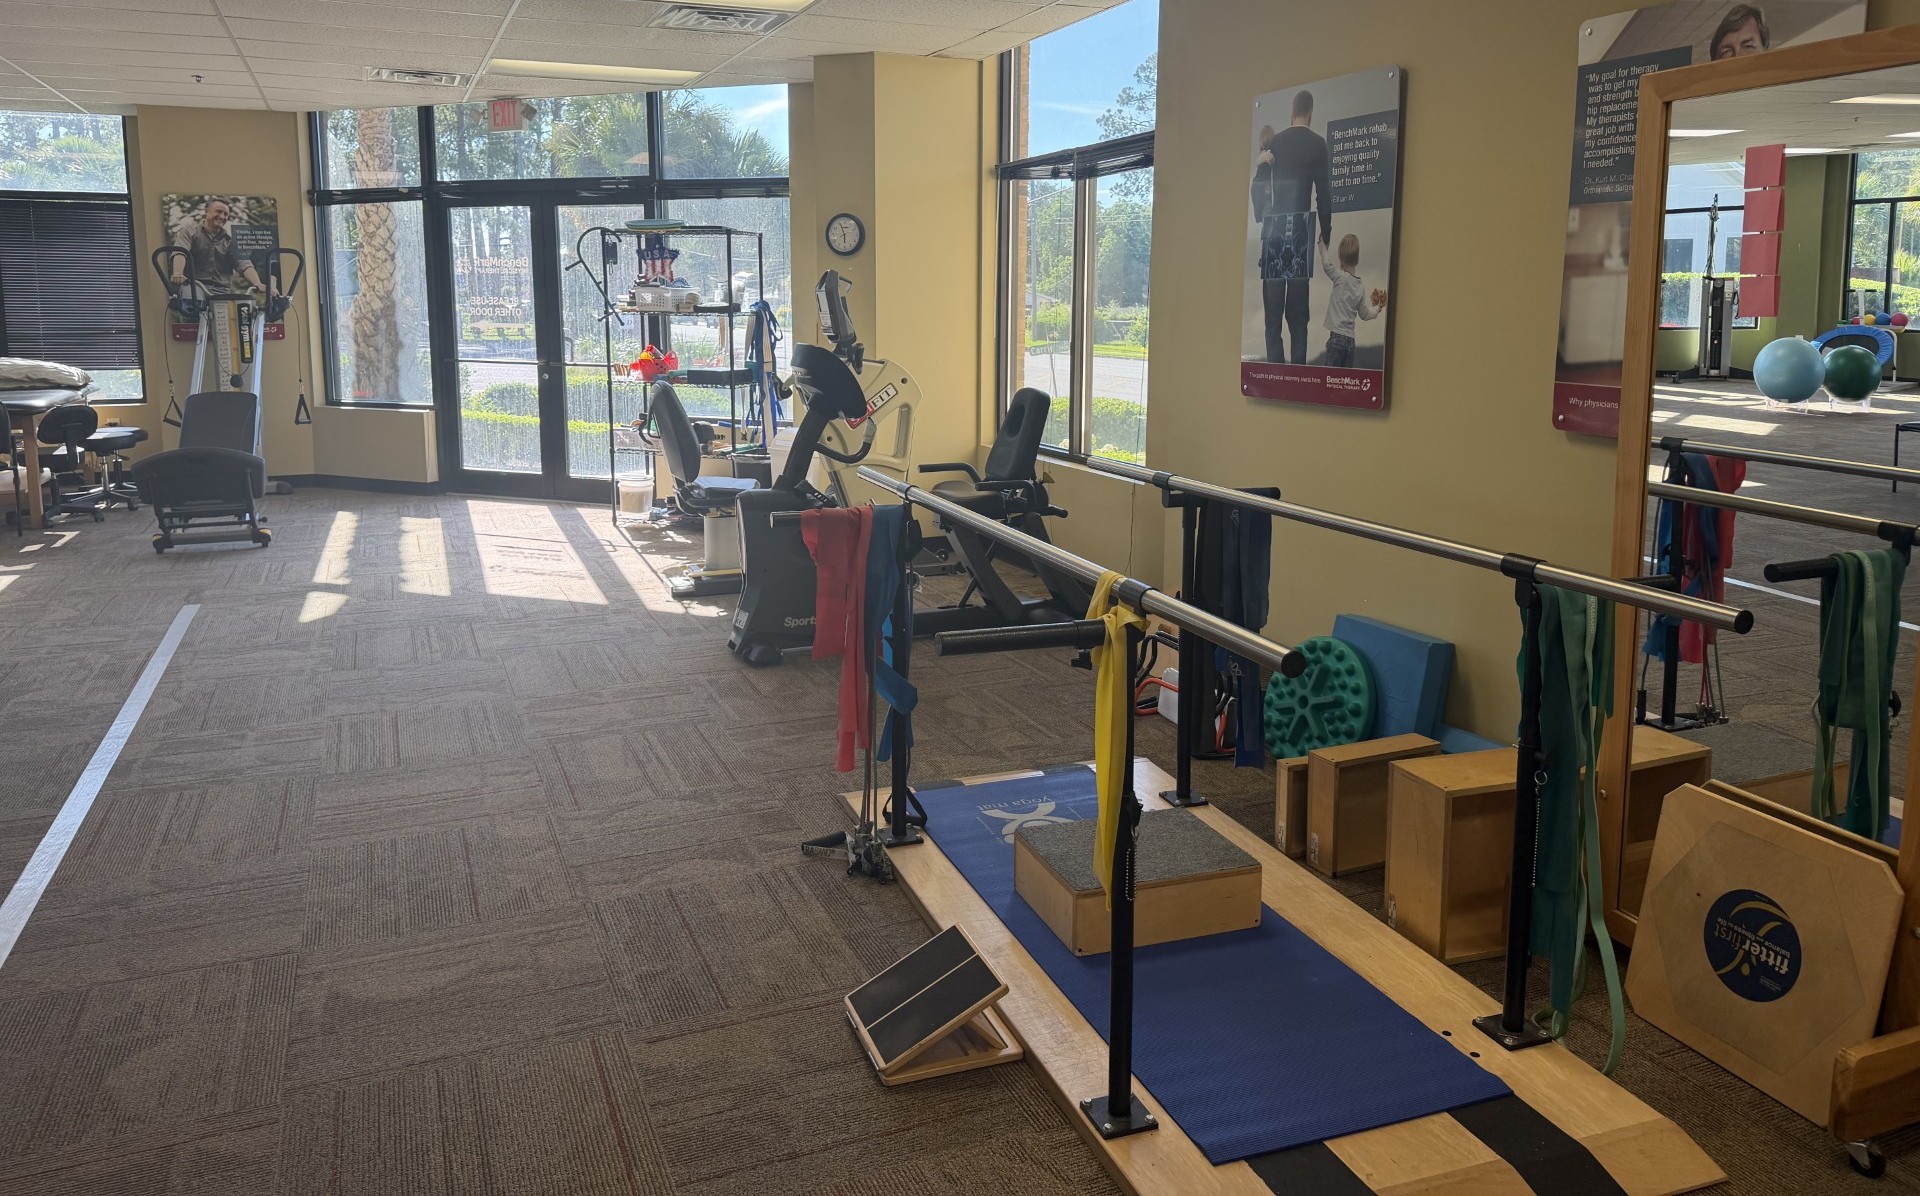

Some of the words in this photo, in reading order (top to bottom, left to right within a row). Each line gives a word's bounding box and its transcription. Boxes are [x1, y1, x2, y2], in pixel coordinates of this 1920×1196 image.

[1601, 69, 1617, 82] goal
[1618, 67, 1629, 77] for
[1630, 63, 1660, 75] therapy
[1588, 84, 1603, 93] was
[1604, 81, 1612, 91] to
[1613, 79, 1625, 91] get
[1627, 78, 1639, 88] my
[1587, 94, 1601, 104] and
[1602, 88, 1633, 102] strength
[493, 100, 517, 127] EXIT
[1587, 106, 1598, 116] hip
[1599, 101, 1638, 114] replaceme
[1586, 116, 1597, 127] My
[1598, 111, 1635, 124] therapists
[1369, 122, 1388, 133] rehab
[1585, 126, 1604, 139] great
[1604, 124, 1617, 136] job
[1618, 121, 1634, 133] with
[1333, 142, 1343, 153] got
[1343, 141, 1354, 150] me
[1354, 138, 1370, 149] back
[1371, 137, 1378, 146] to
[1584, 139, 1596, 148] my
[1597, 134, 1637, 146] confidence
[1332, 153, 1358, 164] enjoying
[1358, 150, 1380, 161] quality
[1584, 145, 1636, 158] accomplishing
[1332, 165, 1350, 176] family
[1351, 164, 1365, 173] time
[1366, 162, 1373, 171] in
[1331, 177, 1344, 188] next
[1345, 177, 1352, 187] to
[1352, 177, 1361, 185] no
[1326, 375, 1360, 386] BenchMark
[1569, 397, 1583, 407] Why
[1584, 398, 1619, 409] physicians
[1717, 916, 1728, 928] life
[1734, 924, 1756, 942] fitness
[1764, 940, 1791, 959] balance
